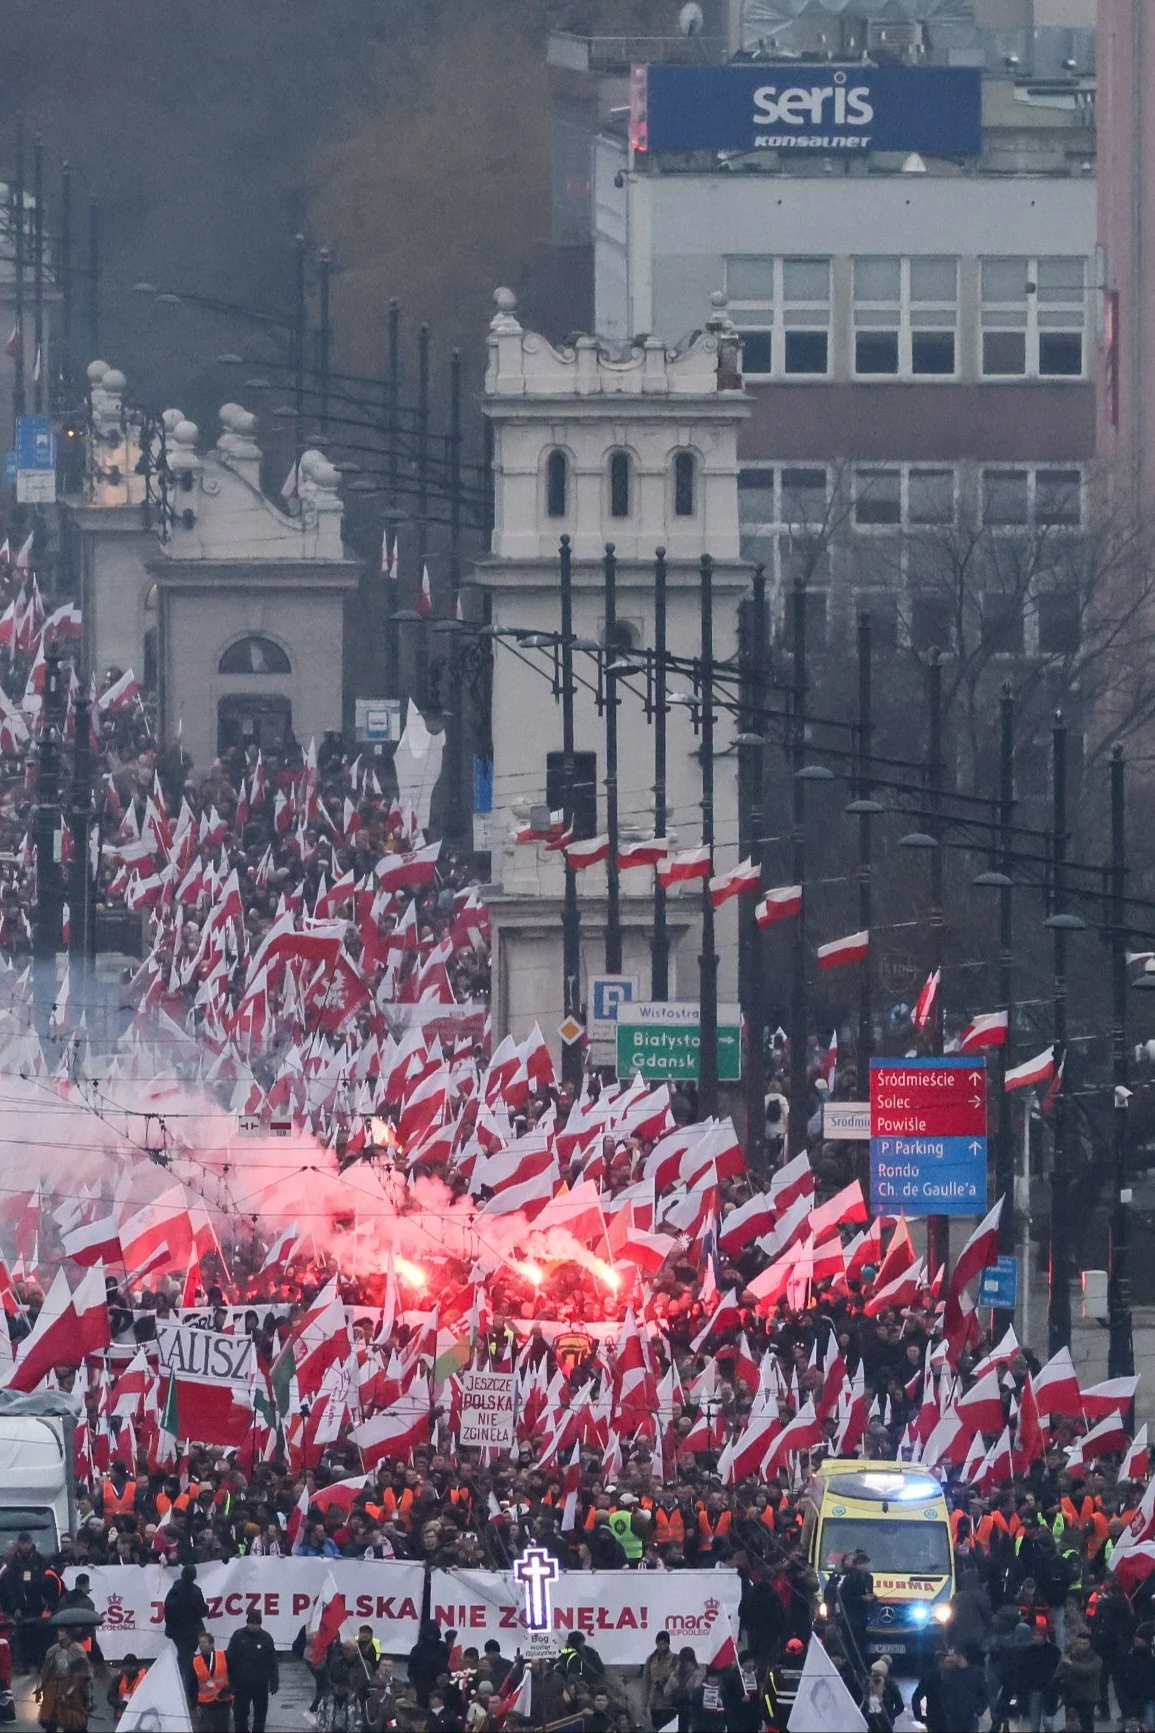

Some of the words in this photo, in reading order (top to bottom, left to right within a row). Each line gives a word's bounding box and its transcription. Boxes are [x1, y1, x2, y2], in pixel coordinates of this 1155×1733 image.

[753, 71, 874, 125] seris
[639, 1007, 700, 1018] Wisłostra
[633, 1031, 701, 1050] Białysto
[877, 1070, 955, 1087] Śródmieście
[877, 1095, 911, 1109] Solec
[877, 1117, 926, 1131] Powiśle
[895, 1141, 944, 1159] Parking
[878, 1163, 919, 1177] Rondo
[903, 1182, 919, 1196] de
[156, 1328, 251, 1380] KALISZ
[466, 1375, 513, 1392] JESZCZE
[463, 1394, 512, 1411] POLSKA
[478, 1412, 498, 1426] NIE
[463, 1427, 509, 1442] ZGINĘŁA
[150, 1592, 280, 1624] JZCZE
[292, 1593, 418, 1620] PLSKA
[434, 1605, 487, 1628] NIE
[498, 1606, 649, 1637] ZNĘŁA!
